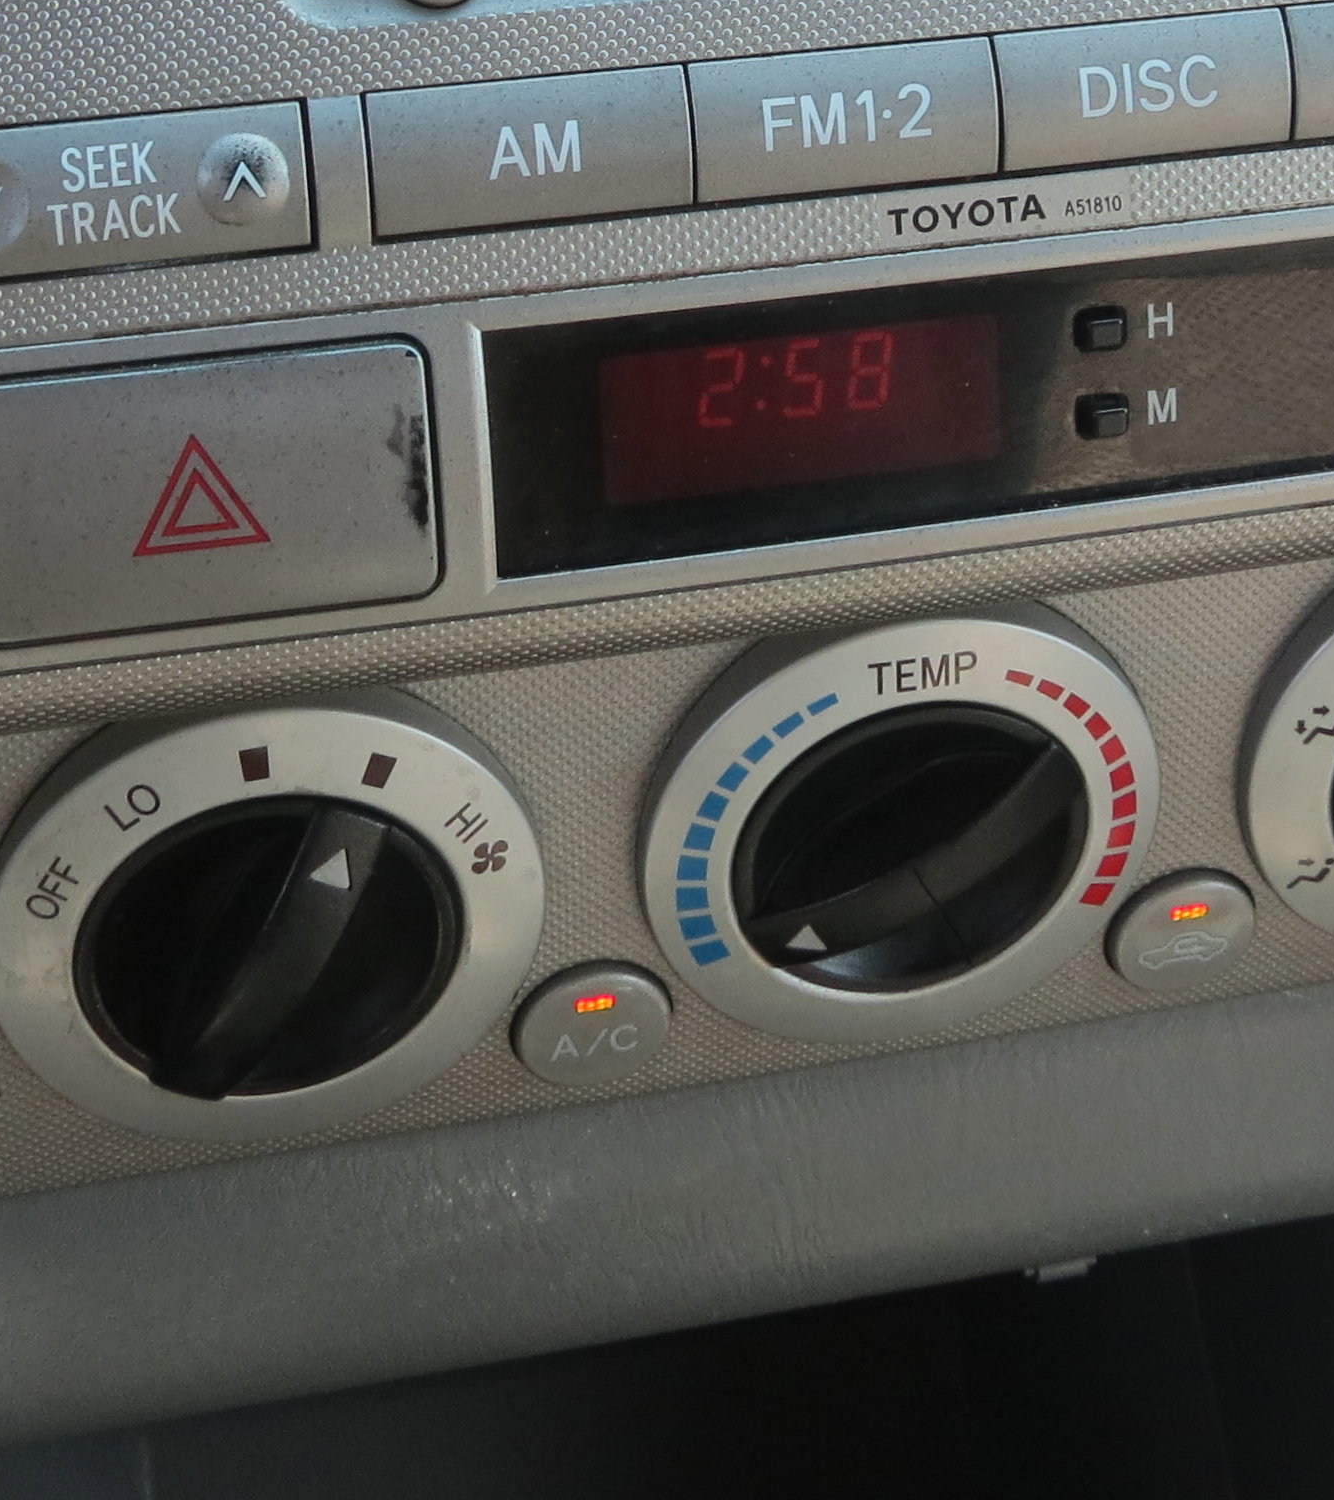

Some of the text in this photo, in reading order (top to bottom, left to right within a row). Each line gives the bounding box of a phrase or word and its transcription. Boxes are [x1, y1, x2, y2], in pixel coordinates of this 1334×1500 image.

[1078, 53, 1219, 120] DISC
[60, 140, 158, 193] SEEK
[489, 119, 583, 181] AM
[46, 192, 182, 248] TRACK
[887, 193, 1123, 237] TOYOTA A51810
[1146, 303, 1175, 340] H
[697, 330, 894, 429] 2:58
[1145, 388, 1178, 426] M
[867, 650, 979, 697] TEMP
[104, 784, 161, 832] LO
[444, 802, 488, 844] HI
[25, 856, 80, 920] OFF
[550, 1024, 639, 1063] A/C
